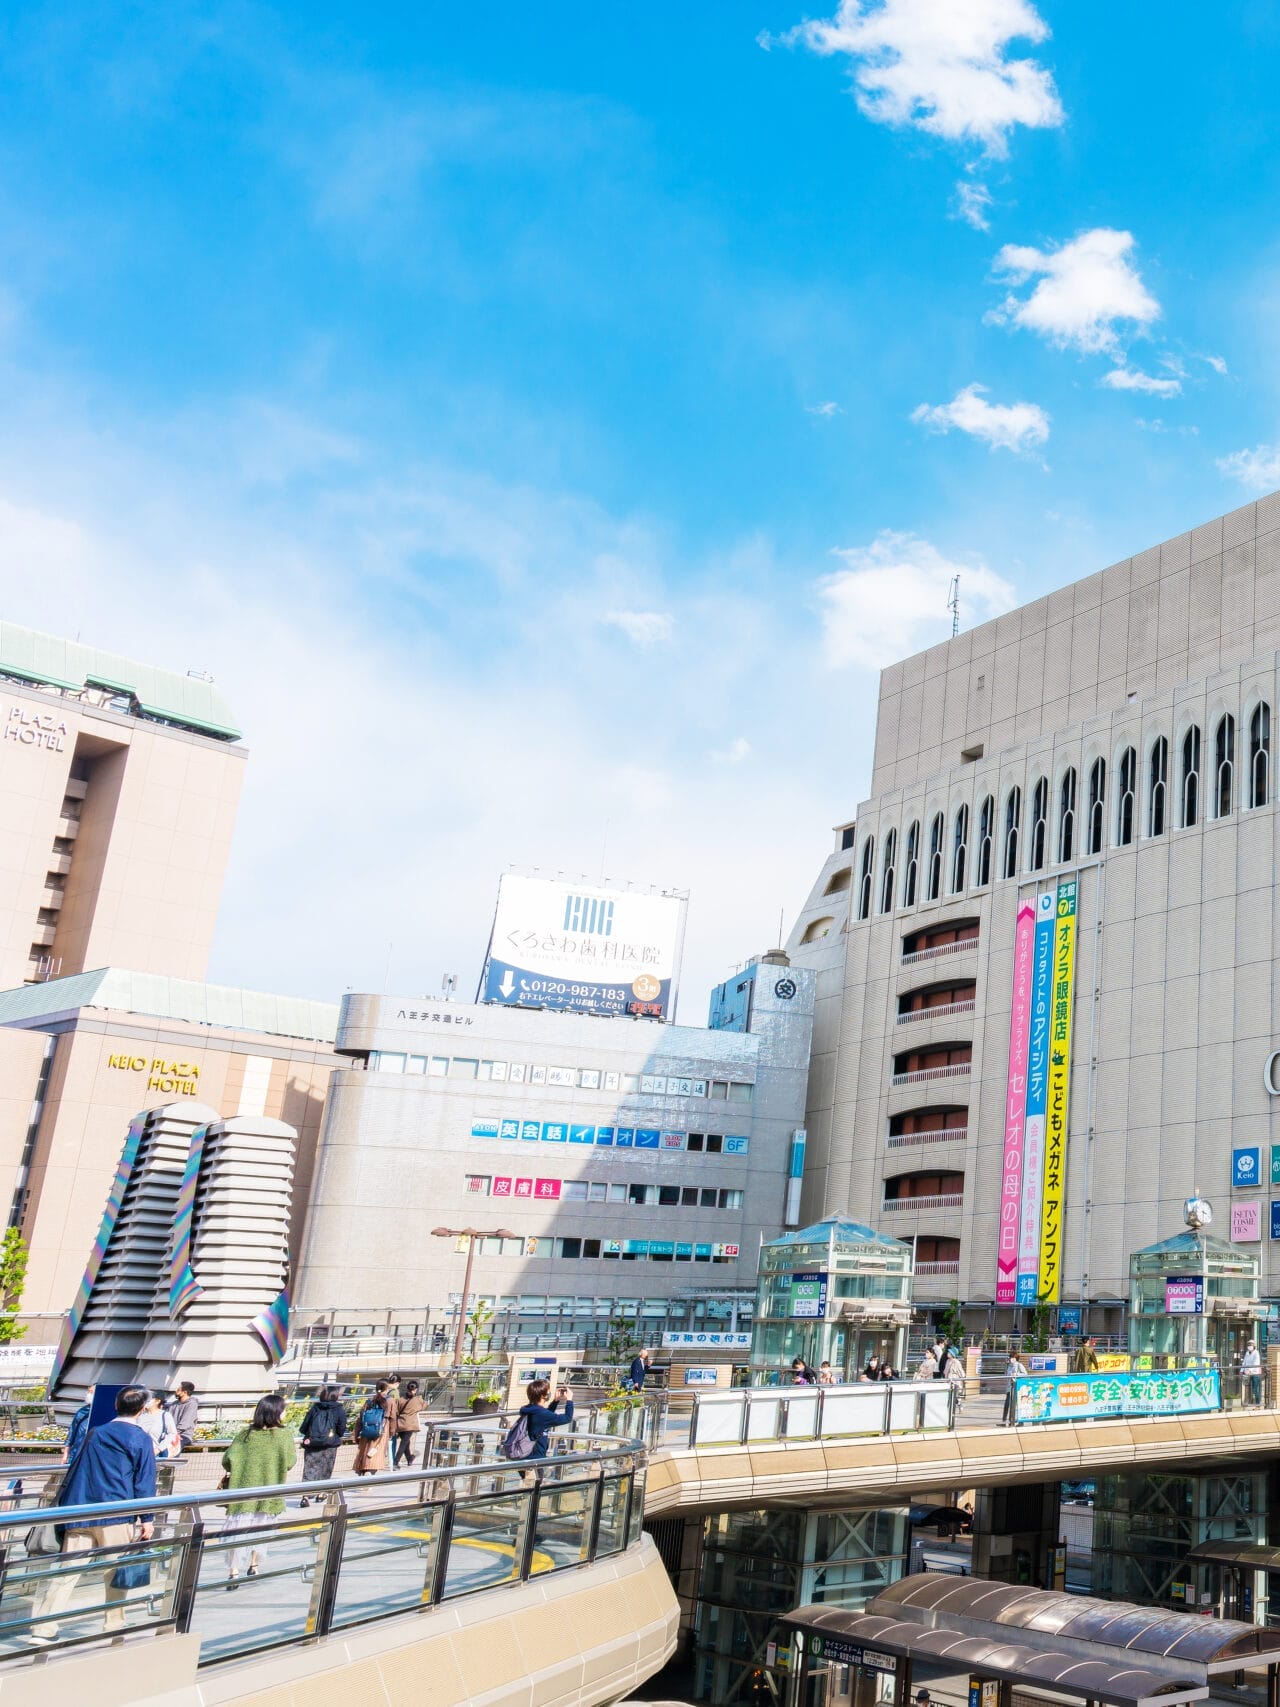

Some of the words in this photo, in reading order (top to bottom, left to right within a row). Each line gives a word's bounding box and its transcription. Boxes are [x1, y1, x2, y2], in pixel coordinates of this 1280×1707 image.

[9, 706, 67, 735] PLAZA
[4, 724, 64, 753] HOTEL
[1059, 883, 1075, 898] 北館
[506, 930, 661, 965] くろさわ歯科医院
[531, 980, 626, 1000] 0120-987-183
[1054, 925, 1071, 1041] オグラ眼鏡店
[397, 1010, 473, 1025] 八王子交通ビル
[1031, 932, 1049, 1102] コンタクトのアイシティ
[108, 1053, 146, 1072] KEIO
[150, 1058, 200, 1079] PLAZA
[147, 1077, 198, 1096] HOTEL
[501, 1122, 655, 1145] 英会話イーオン
[1047, 1072, 1063, 1190] こどもメガネ
[728, 1136, 744, 1152] 6F
[1002, 1073, 1024, 1250] セレオの母の日
[1237, 1171, 1254, 1179] Keio
[495, 1181, 554, 1195] 皮膚科
[1233, 1210, 1257, 1218] ISETAN
[1233, 1218, 1256, 1226] COSME
[1233, 1226, 1248, 1235] TICS
[726, 1246, 738, 1255] 4F
[1043, 1200, 1058, 1297] アンファン
[997, 1289, 1015, 1298] CELEO
[1020, 1278, 1035, 1290] 北館
[1092, 1376, 1214, 1402] 安全・安心まちづくり
[825, 1640, 861, 1655] サイエンスドーム
